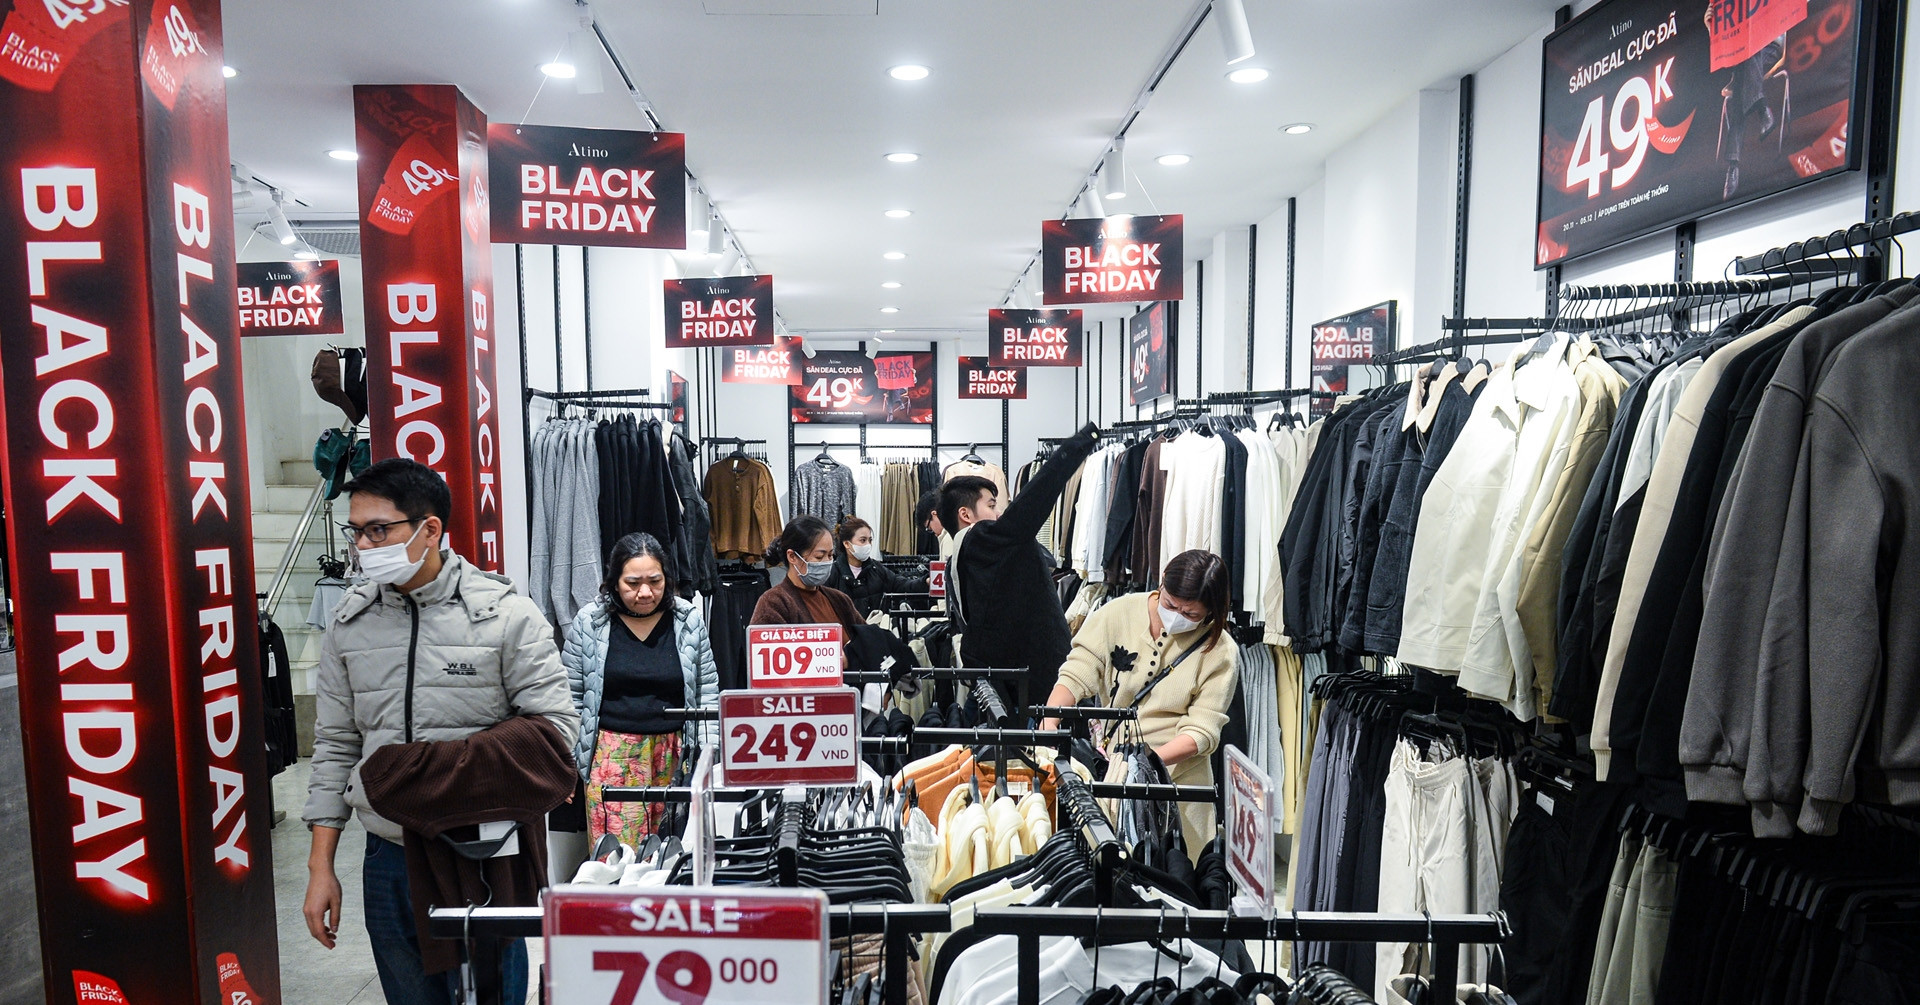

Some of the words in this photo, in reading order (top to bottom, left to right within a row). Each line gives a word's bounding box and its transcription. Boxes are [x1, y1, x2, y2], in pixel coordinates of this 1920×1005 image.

[1609, 19, 1633, 40] Atino
[7, 32, 61, 63] BLACK
[1569, 66, 1592, 94] SĂN
[1594, 48, 1625, 81] DEAL
[1626, 29, 1656, 60] CỰC
[1657, 10, 1677, 45] ĐÃ
[1, 44, 60, 74] FRIDAY
[149, 45, 176, 87] BLACK
[146, 55, 175, 94] FRIDAY
[568, 143, 608, 158] Atino
[402, 160, 459, 195] 49K
[521, 164, 656, 200] BLACK
[375, 205, 413, 224] FRIDAY
[379, 198, 415, 217] BLACK
[522, 200, 656, 233] FRIDAY
[1065, 243, 1161, 269] BLACK
[266, 271, 292, 281] Atino
[1065, 269, 1161, 293] FRIDAY
[237, 284, 323, 306] BLACK
[707, 286, 730, 295] Atino
[239, 307, 323, 328] FRIDAY
[681, 298, 757, 319] BLACK
[682, 319, 757, 339] FRIDAY
[1003, 327, 1069, 343] BLACK
[21, 168, 121, 525] BLACK
[173, 182, 228, 521] BLACK
[734, 349, 790, 364] BLACK
[1003, 345, 1069, 360] FRIDAY
[734, 364, 790, 379] FRIDAY
[878, 360, 911, 371] BLACK
[879, 370, 912, 380] FRIDAY
[969, 370, 1017, 382] BLACK
[387, 283, 447, 483] BLAC
[969, 383, 1017, 395] FRIDAY
[472, 289, 496, 513] BLACK
[760, 628, 781, 641] GIÁ
[783, 626, 805, 642] ĐẶC
[807, 628, 830, 641] BIỆT
[757, 646, 813, 675] 109
[815, 648, 835, 657] 000
[815, 665, 836, 673] VND
[195, 548, 250, 869] FRIDAY
[762, 696, 815, 714] SALE
[50, 551, 150, 901] FRIDAY
[730, 722, 817, 763] 249
[821, 724, 848, 737] 000
[821, 750, 849, 760] VND
[630, 897, 740, 933] SALE
[220, 963, 238, 973] BLACK
[220, 969, 240, 982] FRIDAY
[592, 949, 713, 1005] 79
[720, 957, 778, 983] 000
[79, 982, 119, 996] BLACK
[81, 991, 123, 1005] FRIDAY
